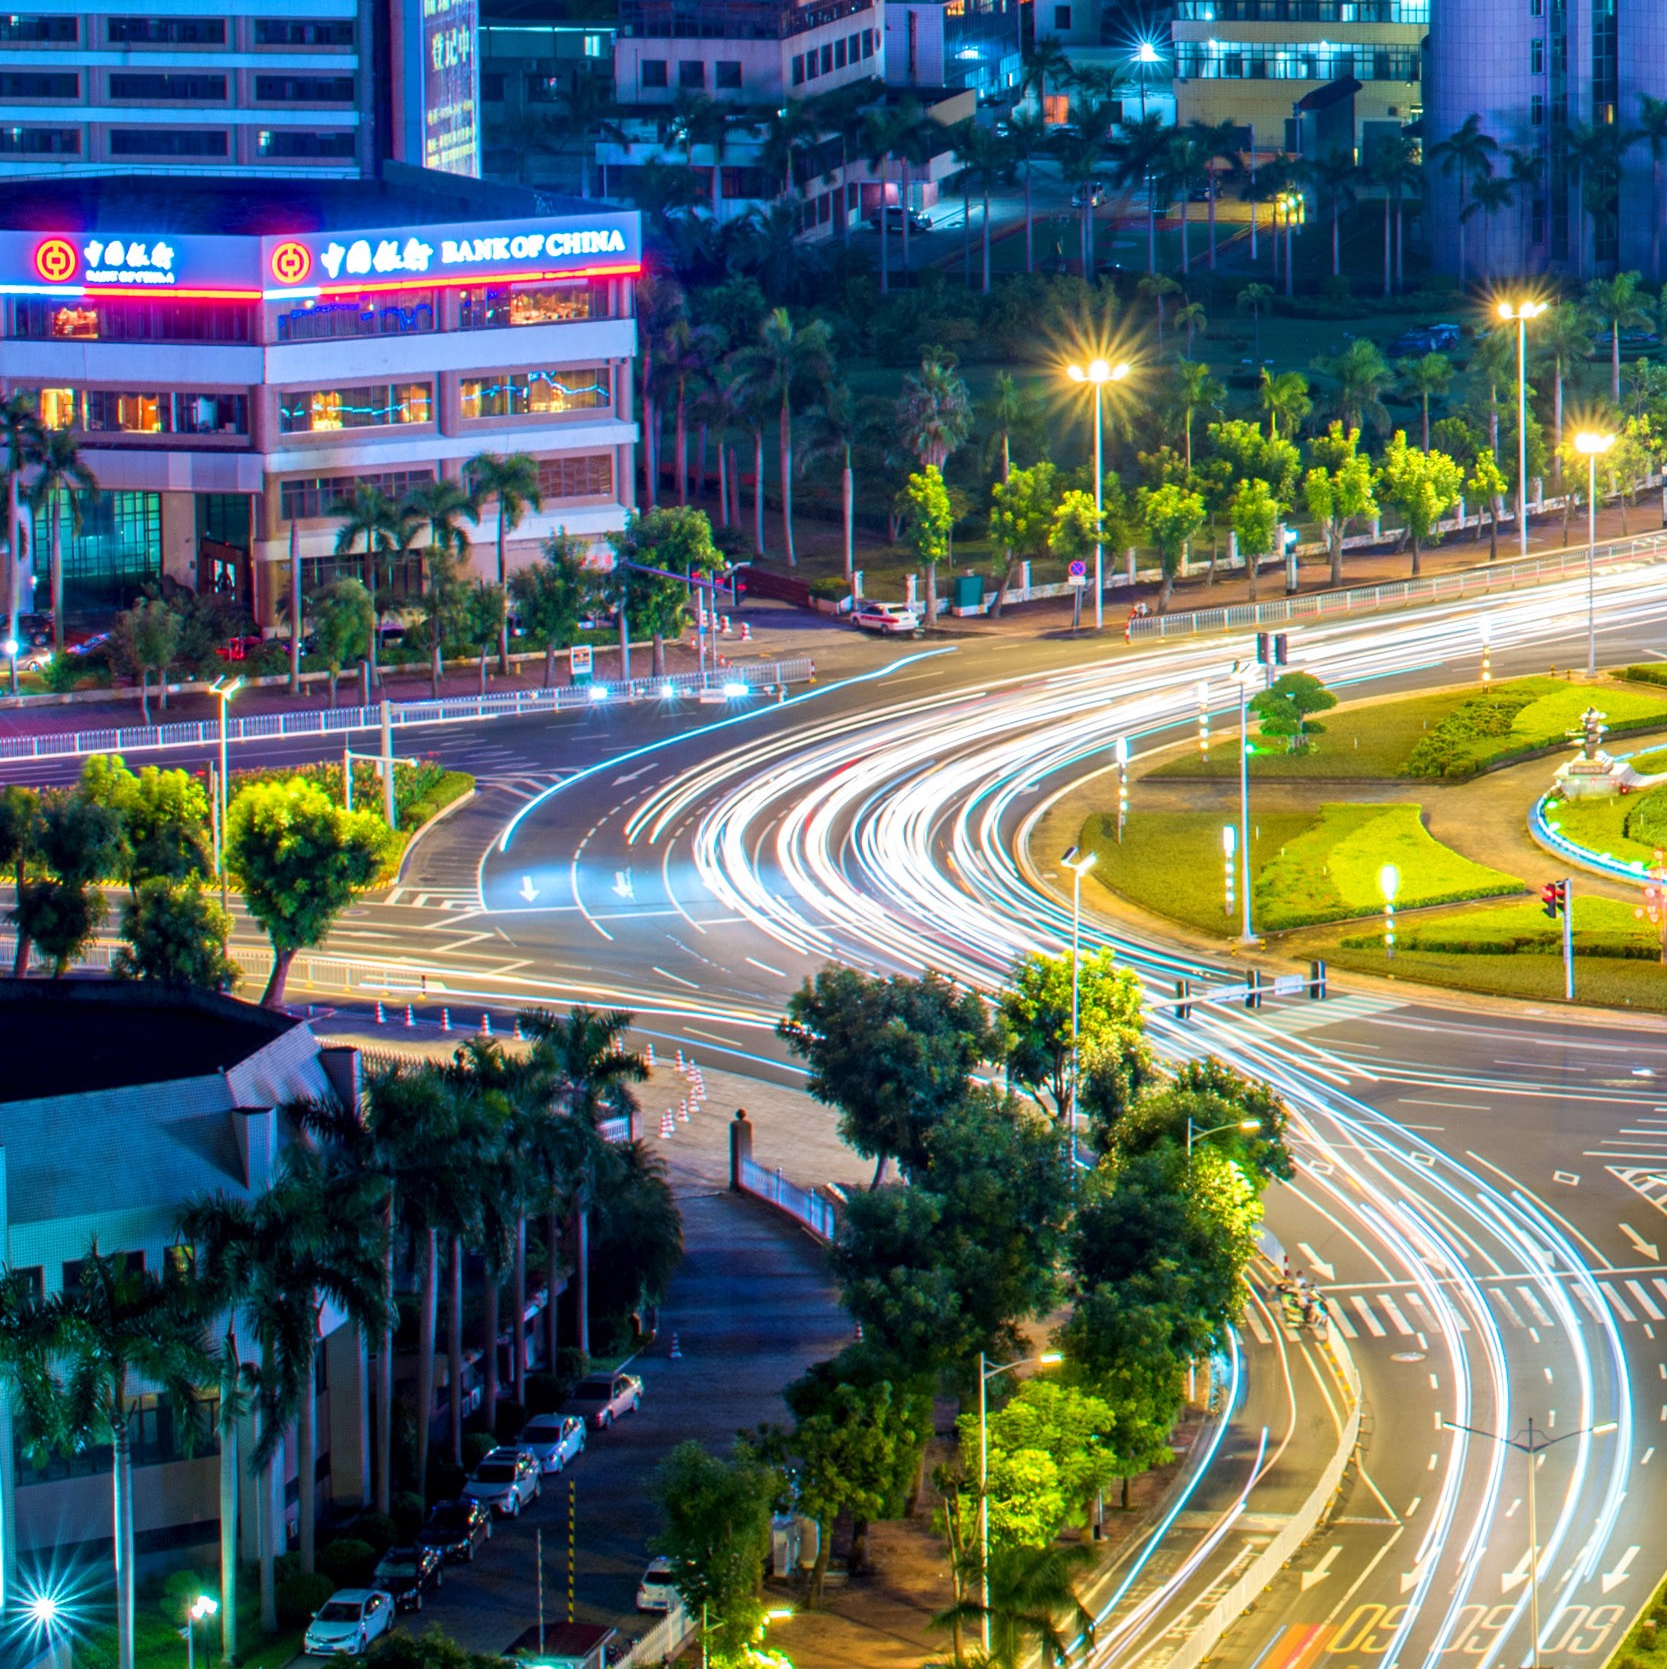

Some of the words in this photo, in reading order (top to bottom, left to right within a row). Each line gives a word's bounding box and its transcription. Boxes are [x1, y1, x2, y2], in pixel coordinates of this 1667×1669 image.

[84, 240, 174, 270] 中国银行
[321, 237, 434, 279] 中国银行
[441, 237, 510, 264] BANK
[510, 234, 545, 258] OF
[546, 229, 626, 257] CHINA
